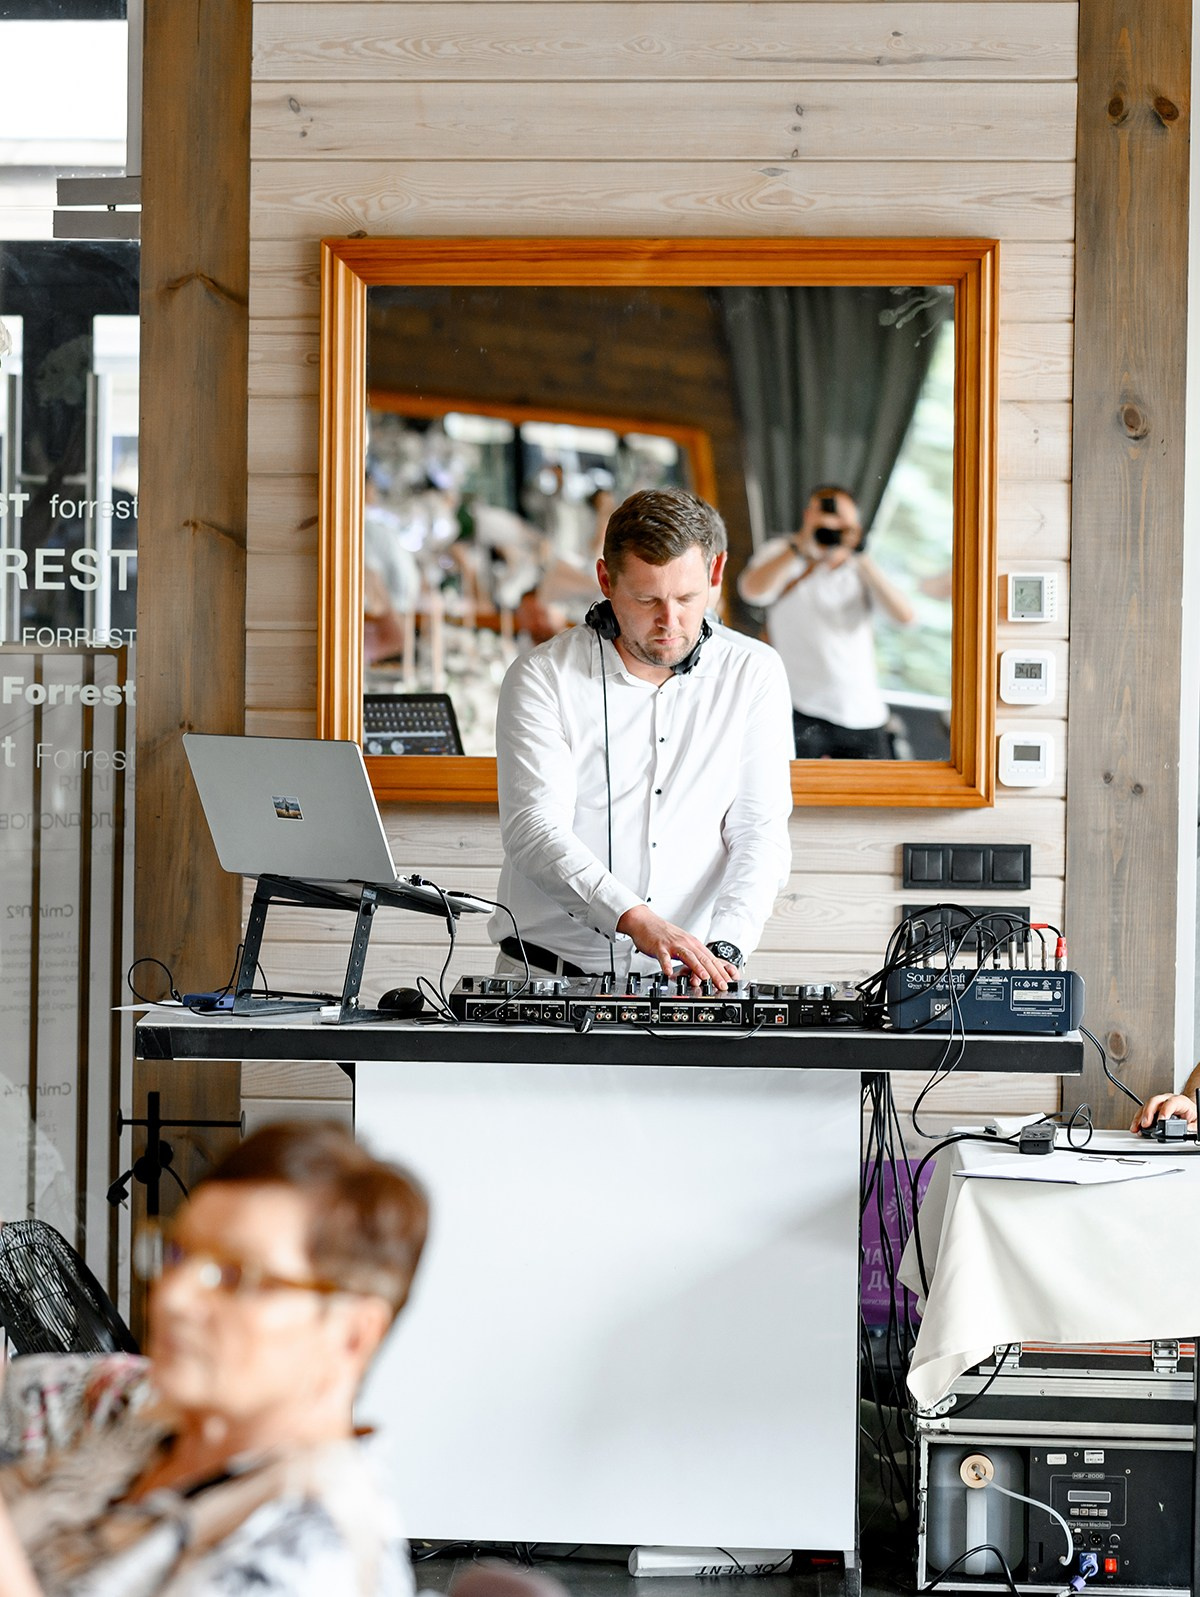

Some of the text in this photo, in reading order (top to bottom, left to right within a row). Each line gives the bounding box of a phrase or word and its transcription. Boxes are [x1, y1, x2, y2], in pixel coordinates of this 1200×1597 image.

[49, 494, 138, 519] forrest
[22, 627, 137, 649] FORREST
[3, 676, 137, 707] Forrest
[36, 743, 136, 771] Forrest
